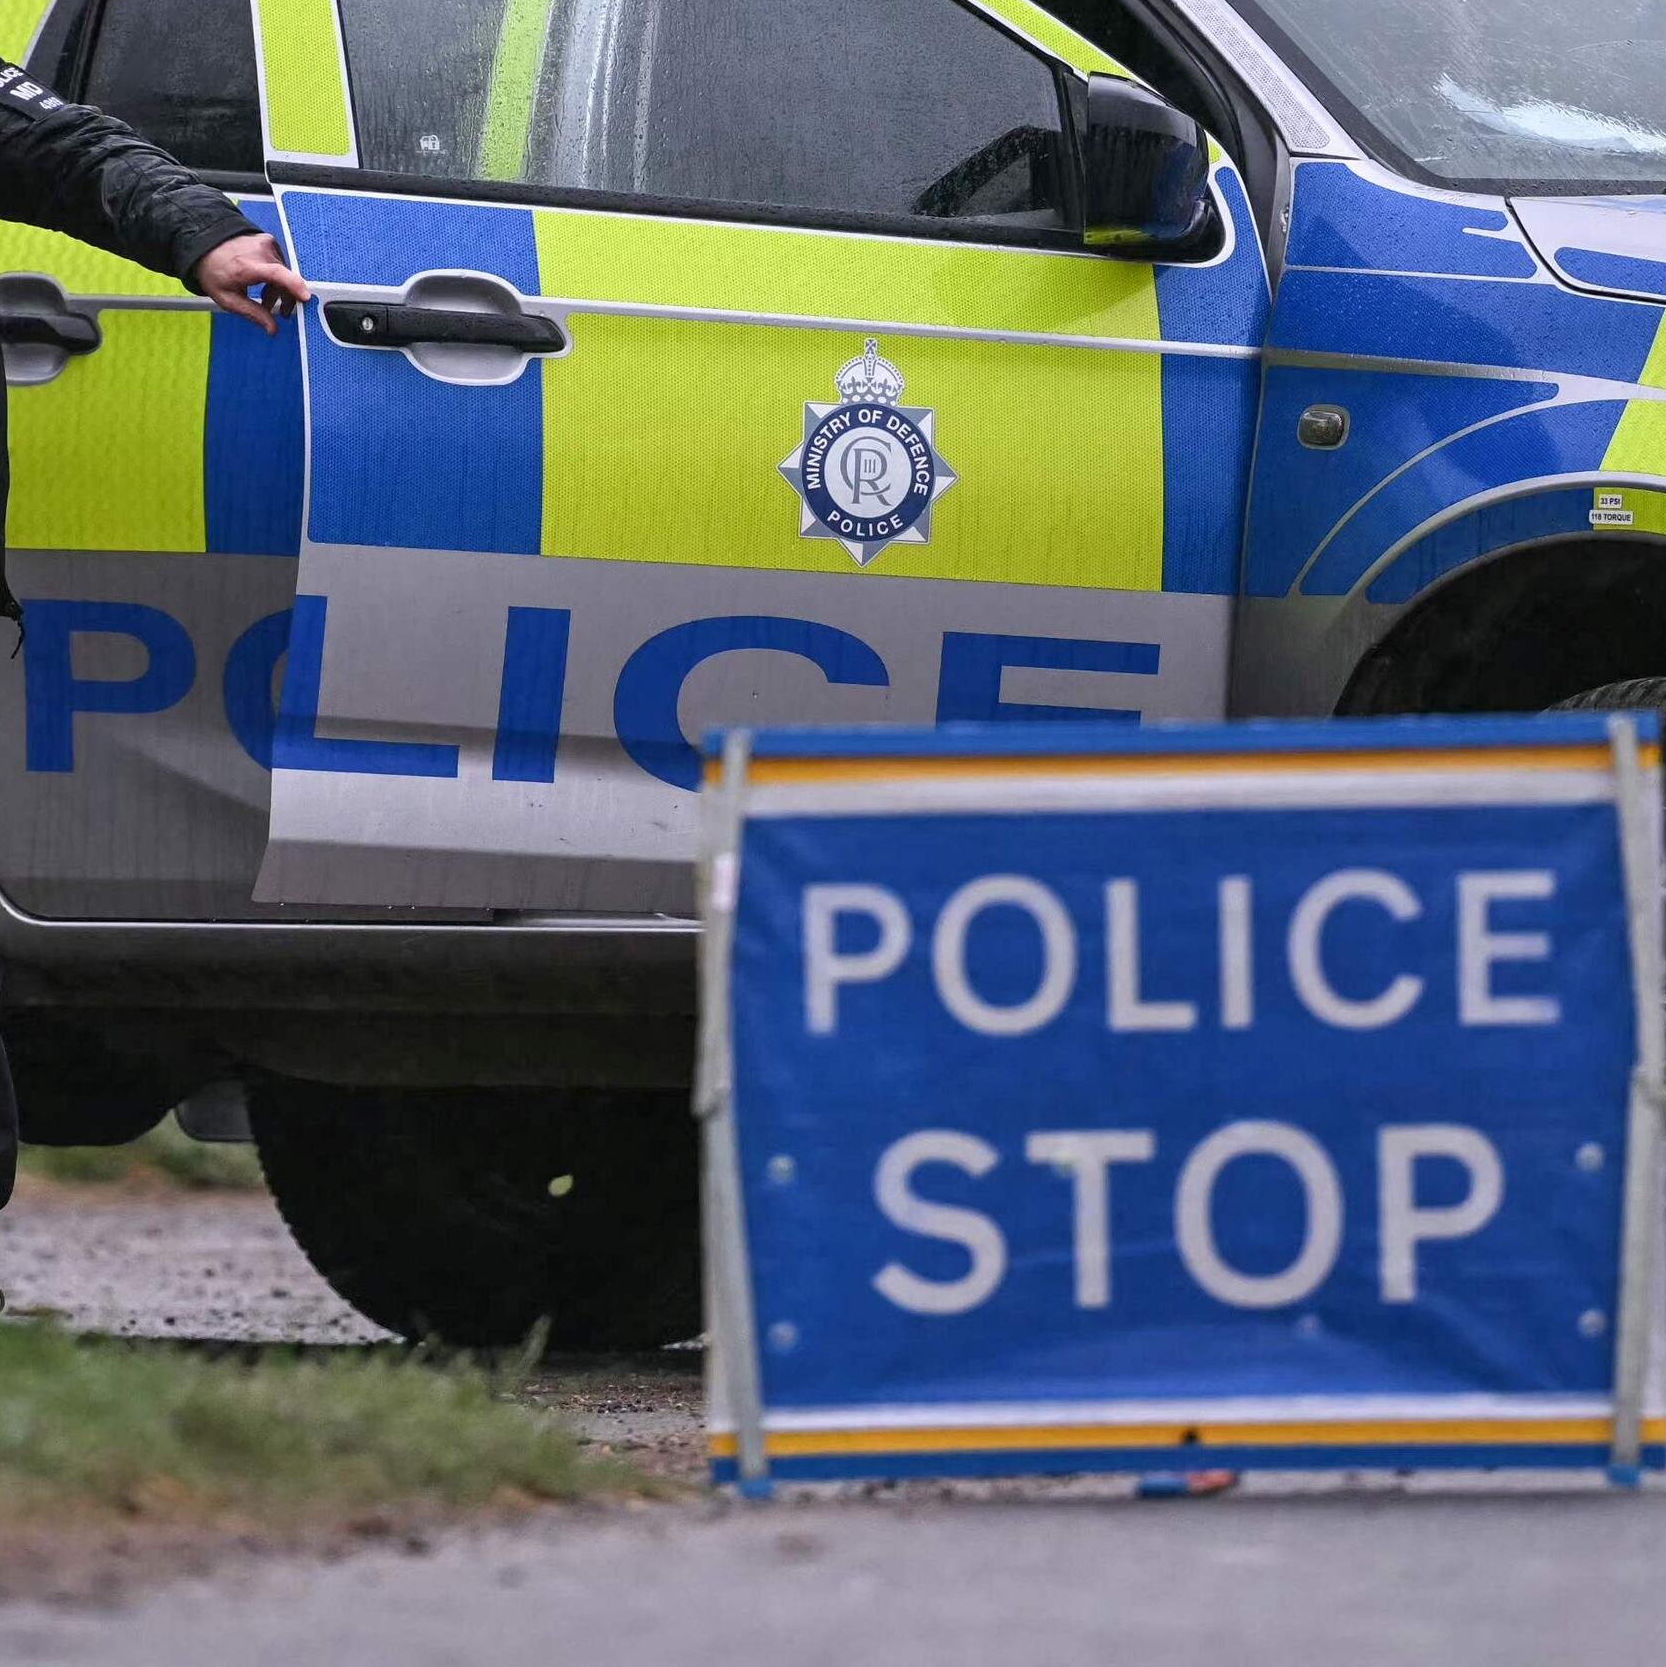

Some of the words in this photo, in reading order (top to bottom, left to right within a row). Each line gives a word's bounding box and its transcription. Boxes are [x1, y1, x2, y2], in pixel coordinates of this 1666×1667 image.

[9, 81, 44, 101] MD
[806, 411, 851, 490] MINISTRY
[858, 409, 883, 424] OF
[886, 415, 930, 496] DEFENCE
[827, 510, 903, 536] POLICE
[1603, 513, 1632, 522] TORQUE
[802, 869, 1560, 1036] POLICE
[871, 1119, 1505, 1315] STOP
